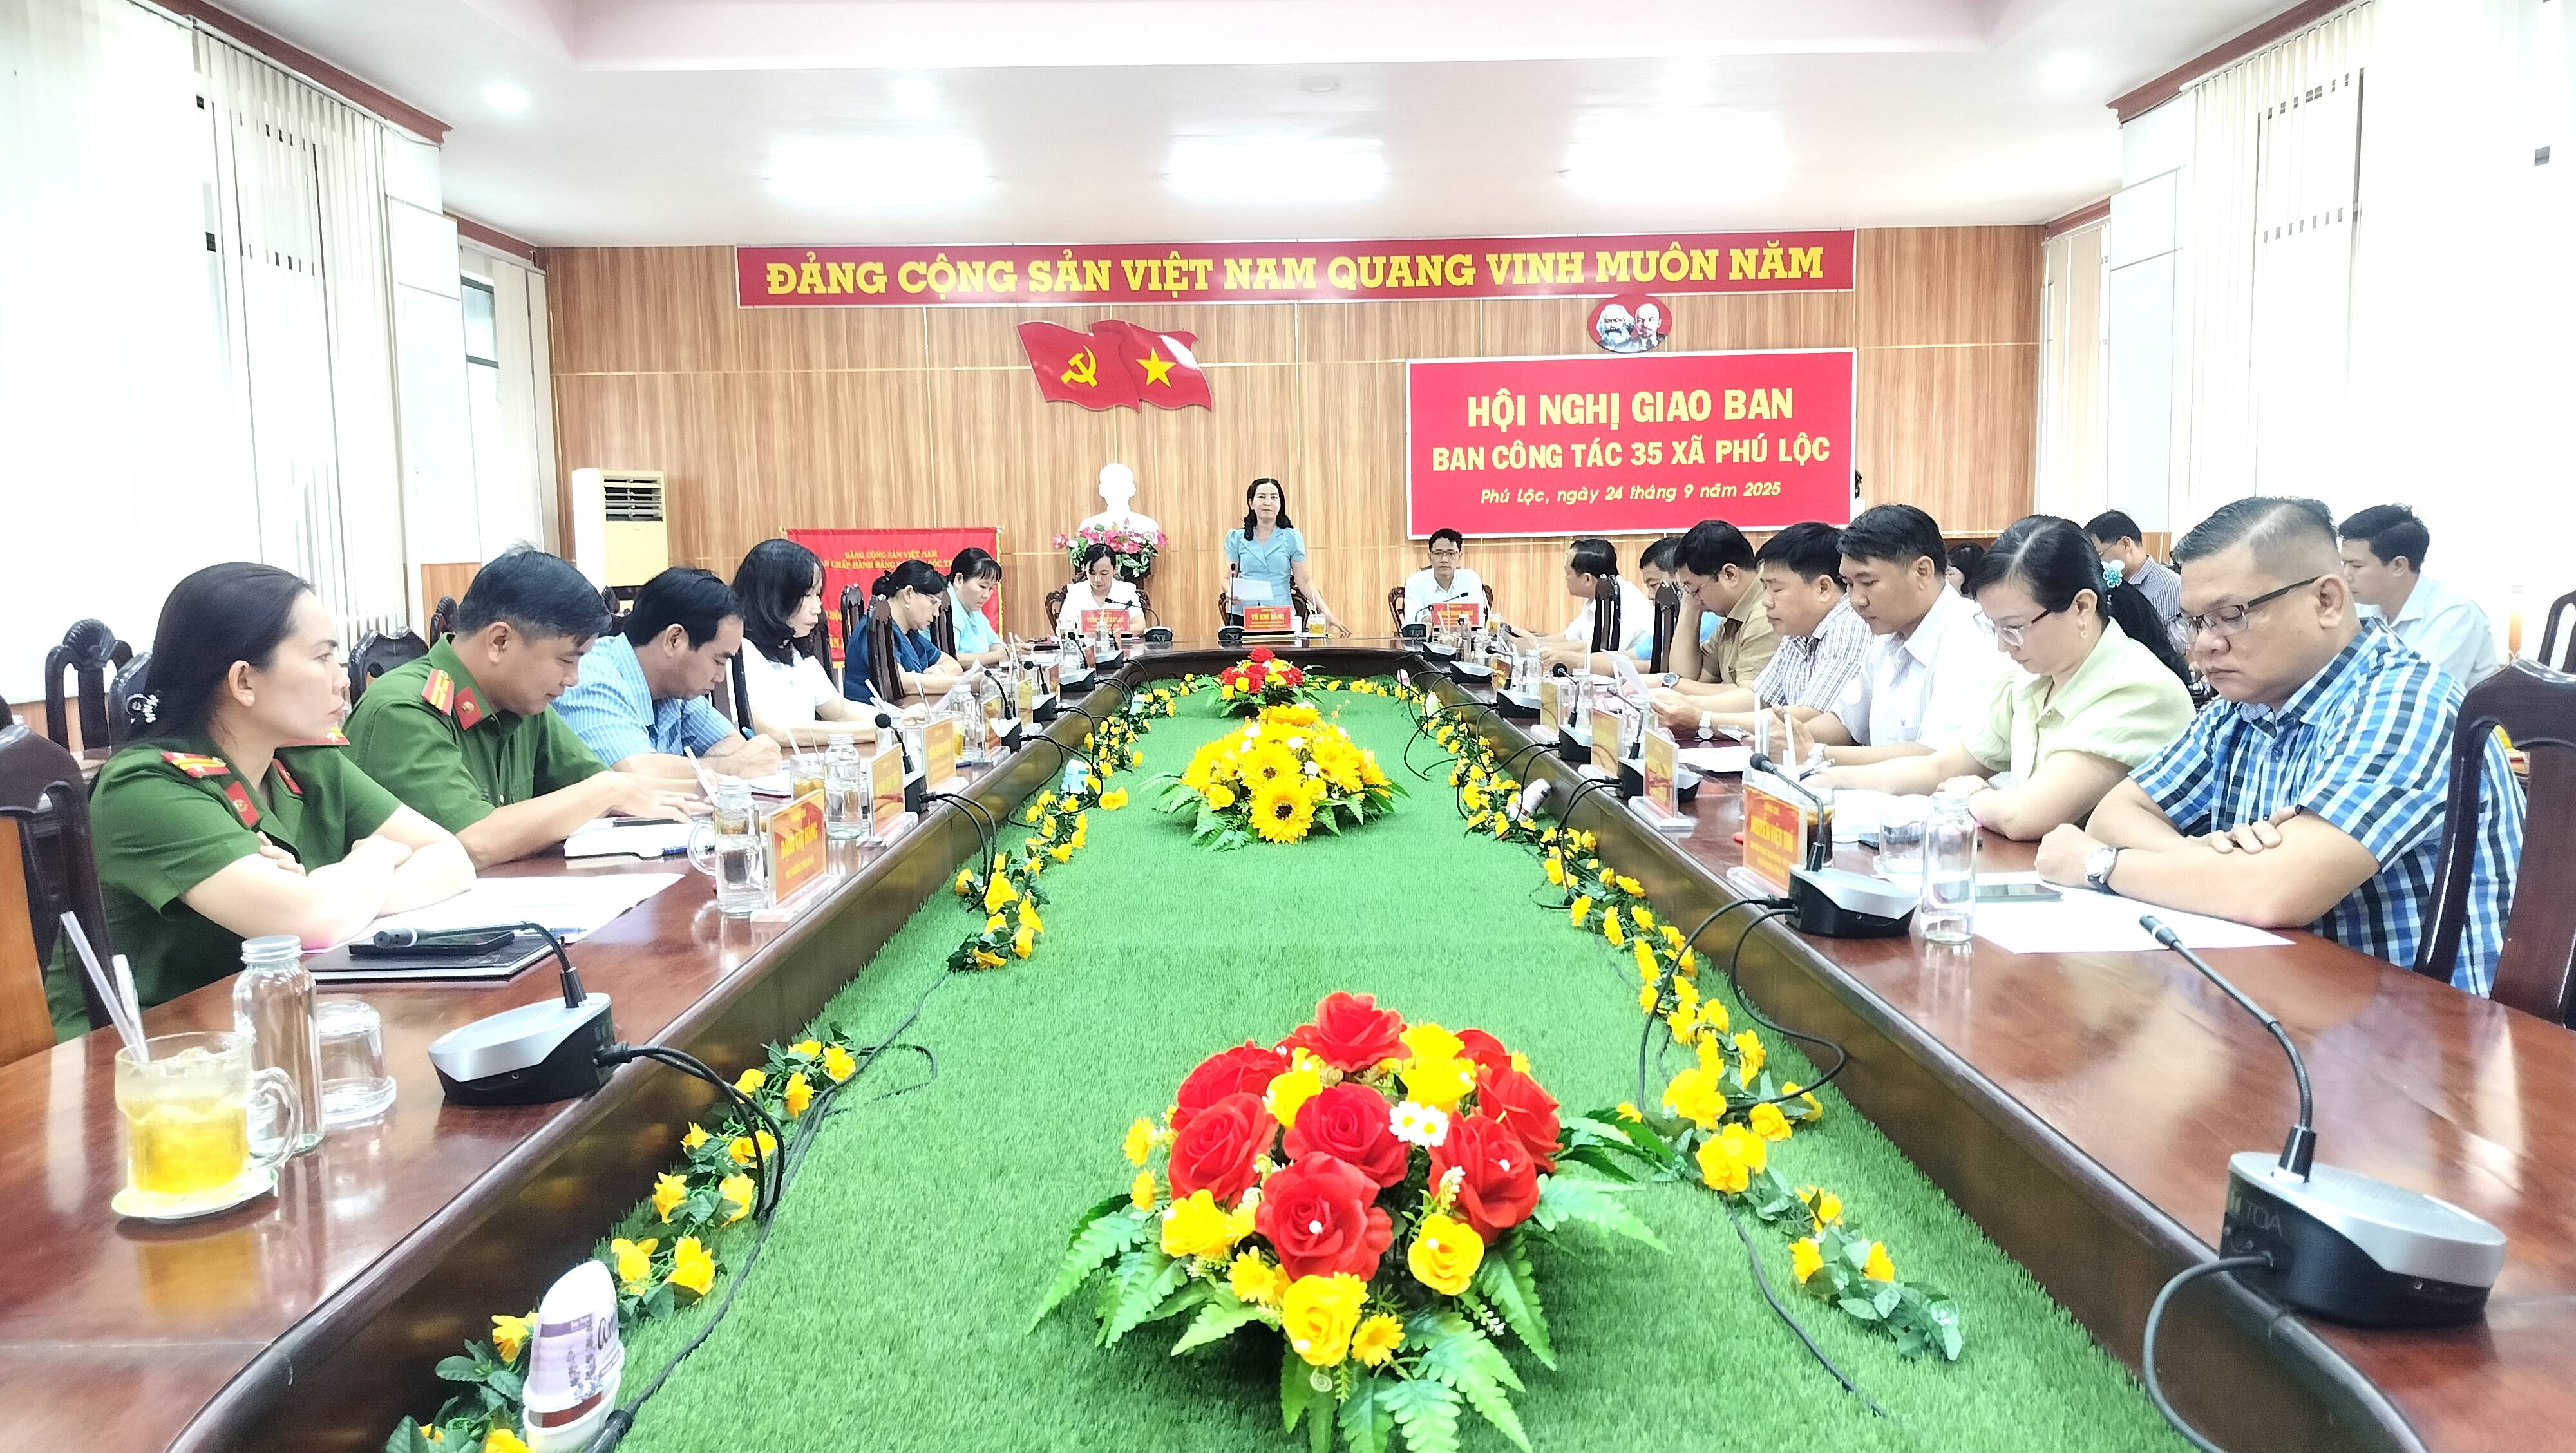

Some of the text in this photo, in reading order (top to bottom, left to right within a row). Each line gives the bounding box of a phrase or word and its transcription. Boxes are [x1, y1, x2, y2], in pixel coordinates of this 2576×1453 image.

[766, 240, 1824, 301] ĐẢNG CỘNG SẢN VIỆT NAM QUANG VINH MUÔN NĂM
[1468, 388, 1793, 433] HỘI NGHỊ GIAO BAN
[1432, 432, 1830, 471] BAN CÔNG TÁC 35 XÃ PHÚ LỘC
[1481, 481, 1781, 506] Phú Lộc, ngày 24 tháng 9 năm 2025
[844, 549, 938, 560] ĐẢNG CỘNG SẢN VIỆT NAM
[2246, 1199, 2283, 1238] TOA
